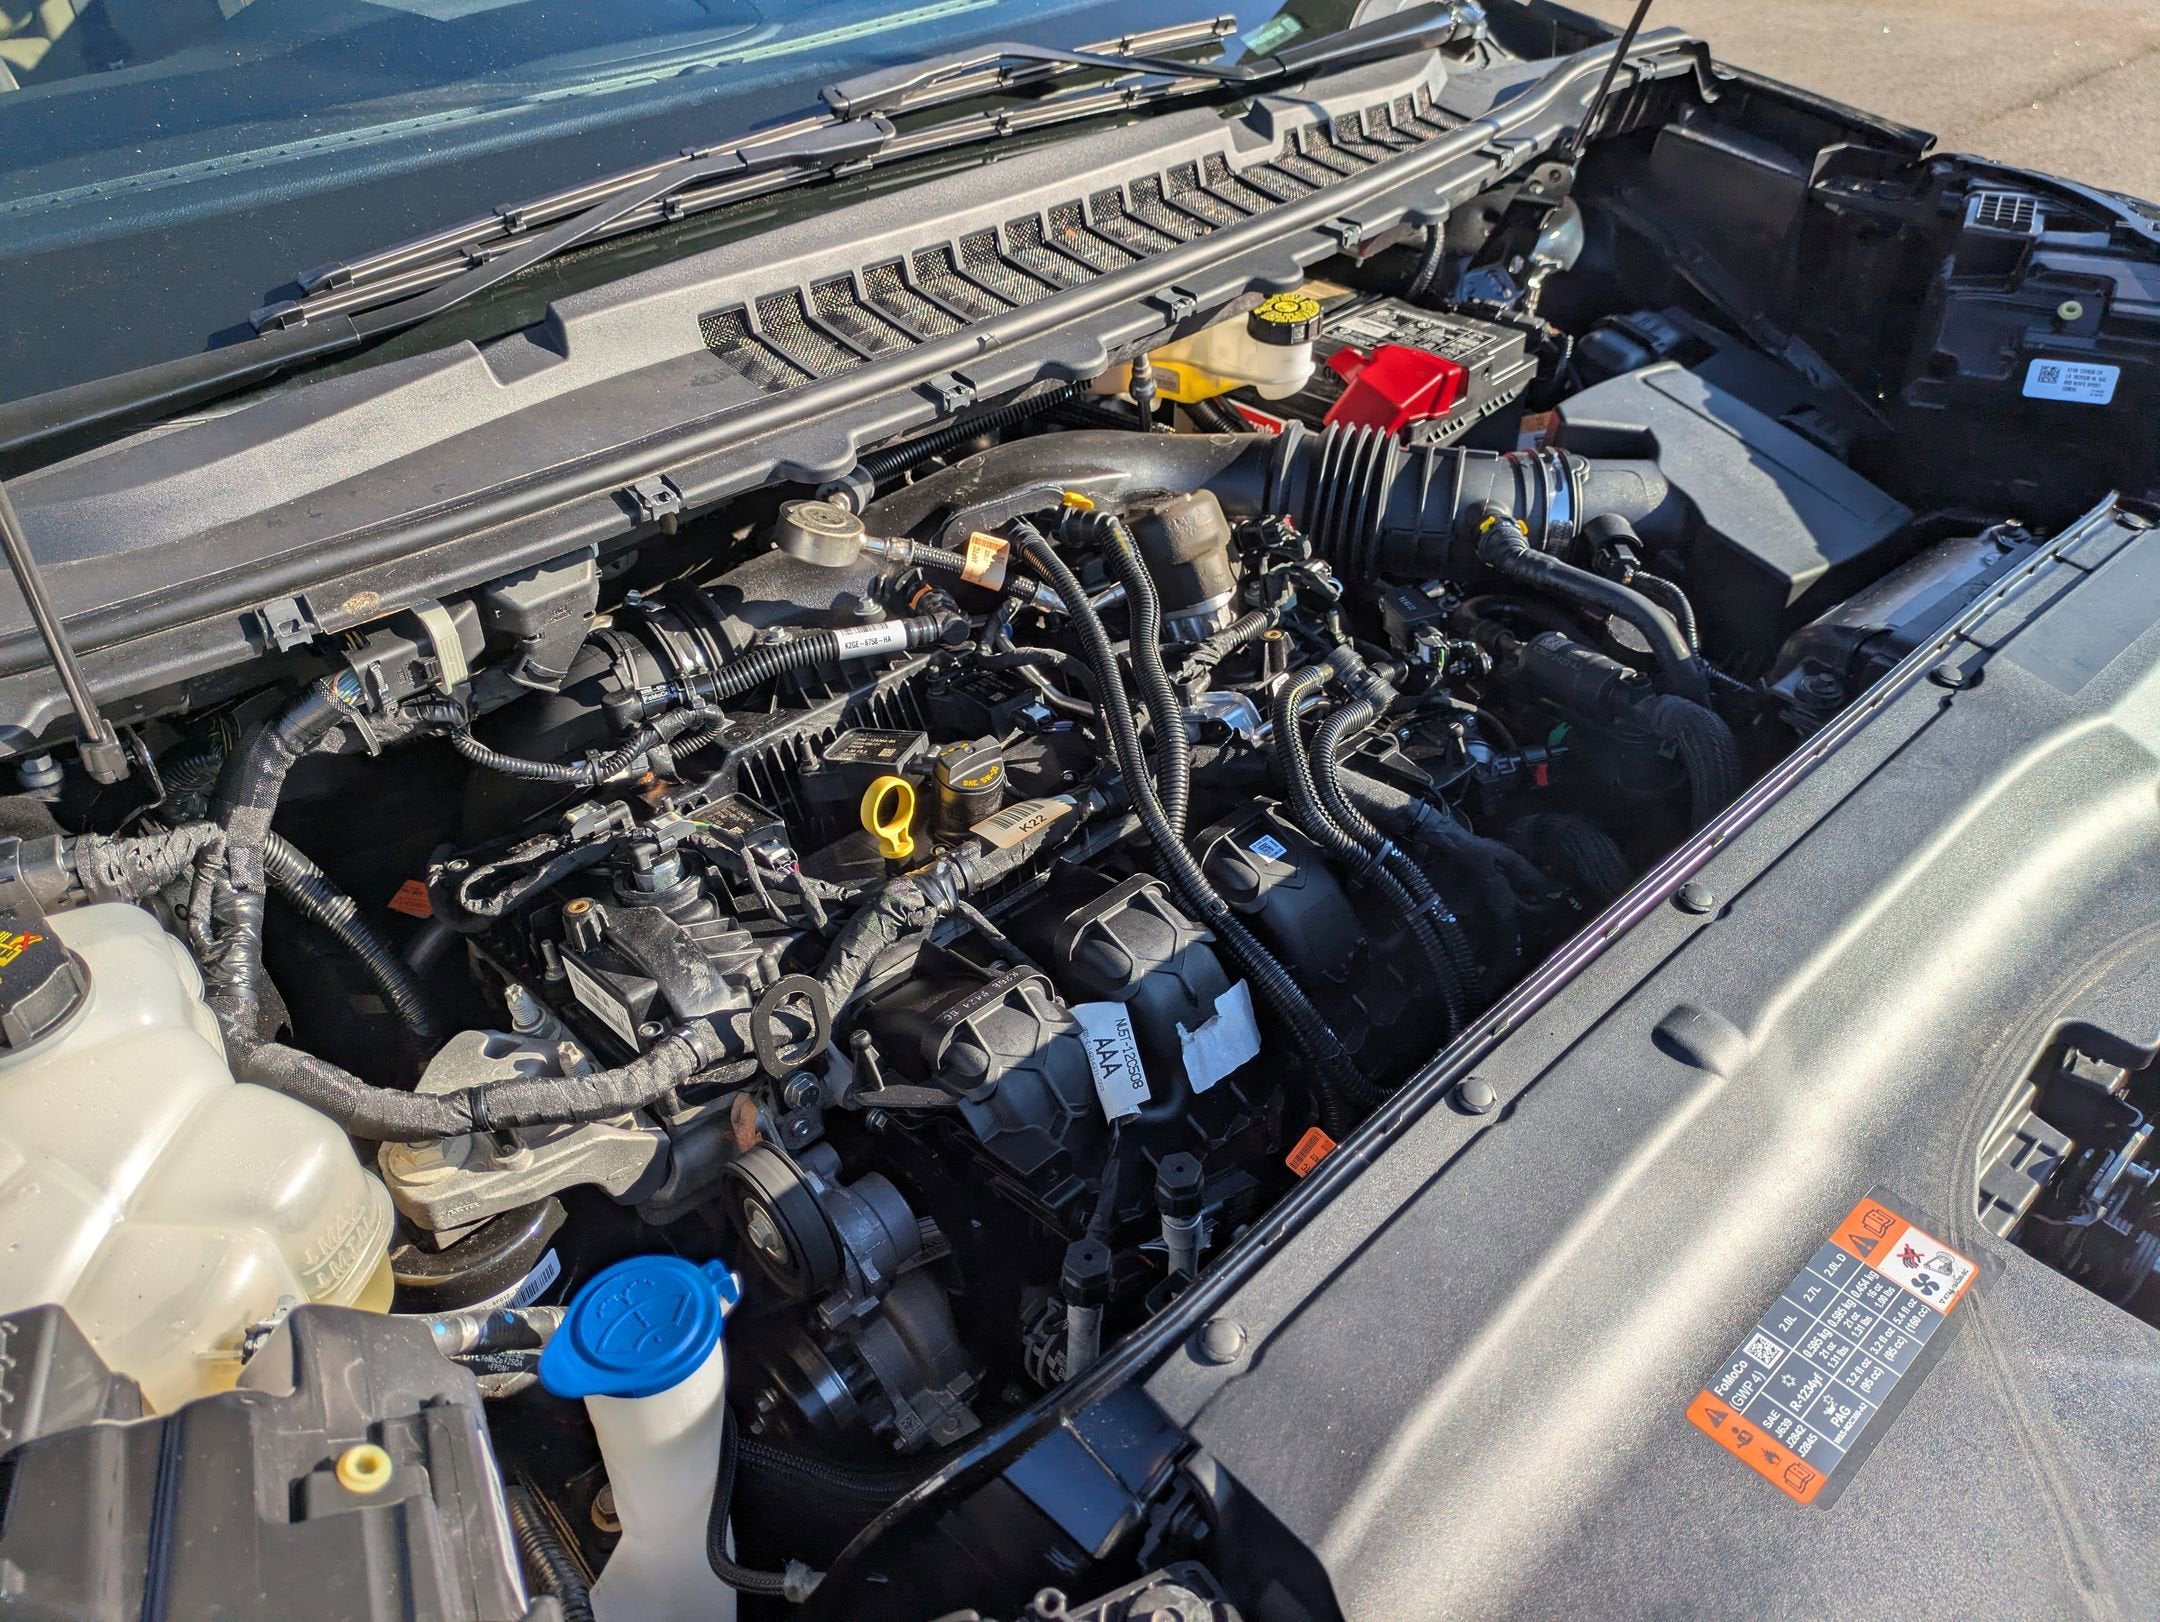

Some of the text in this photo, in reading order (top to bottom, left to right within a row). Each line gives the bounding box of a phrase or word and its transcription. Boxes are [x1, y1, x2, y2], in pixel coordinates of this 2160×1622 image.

[963, 765, 999, 787] SAE 5W-30
[1018, 814, 1047, 833] K22
[1093, 1038, 1123, 1080] AAA
[1115, 1018, 1143, 1090] NU5T-12C508
[1824, 1252, 1847, 1278] 2.0L D
[1803, 1285, 1821, 1302] 2.7L
[1850, 1270, 1880, 1299] 0.454 kg
[1867, 1283, 1884, 1299] 16 oz
[1883, 1286, 1896, 1300] lbs
[1778, 1315, 1797, 1332] 2.0L
[1827, 1299, 1857, 1328] 0.595 kg
[1843, 1311, 1861, 1329] 21 oz
[1893, 1298, 1918, 1326] 5.4 fl oz
[1905, 1304, 1931, 1334] (160 cc)
[1851, 1315, 1873, 1338] 1.31 lbs
[1803, 1328, 1834, 1359] 0.595 kg
[1819, 1342, 1837, 1360] 21 oz
[1870, 1327, 1896, 1355] 3.2 fl oz
[1883, 1335, 1908, 1362] (95 cc)
[1827, 1345, 1850, 1369] 1.31 lbs
[1714, 1360, 1748, 1396] FoMoCo
[1846, 1357, 1872, 1387] 3.2 fl oz
[1859, 1366, 1884, 1393] (95 cc)
[1729, 1370, 1766, 1411] (GWP 4)
[1789, 1372, 1823, 1412] R-1234yf
[1763, 1409, 1781, 1429] SAE
[1775, 1418, 1793, 1438] J639
[1830, 1405, 1851, 1427] PAG
[1785, 1425, 1807, 1449] J2842
[1798, 1433, 1818, 1457] J2845
